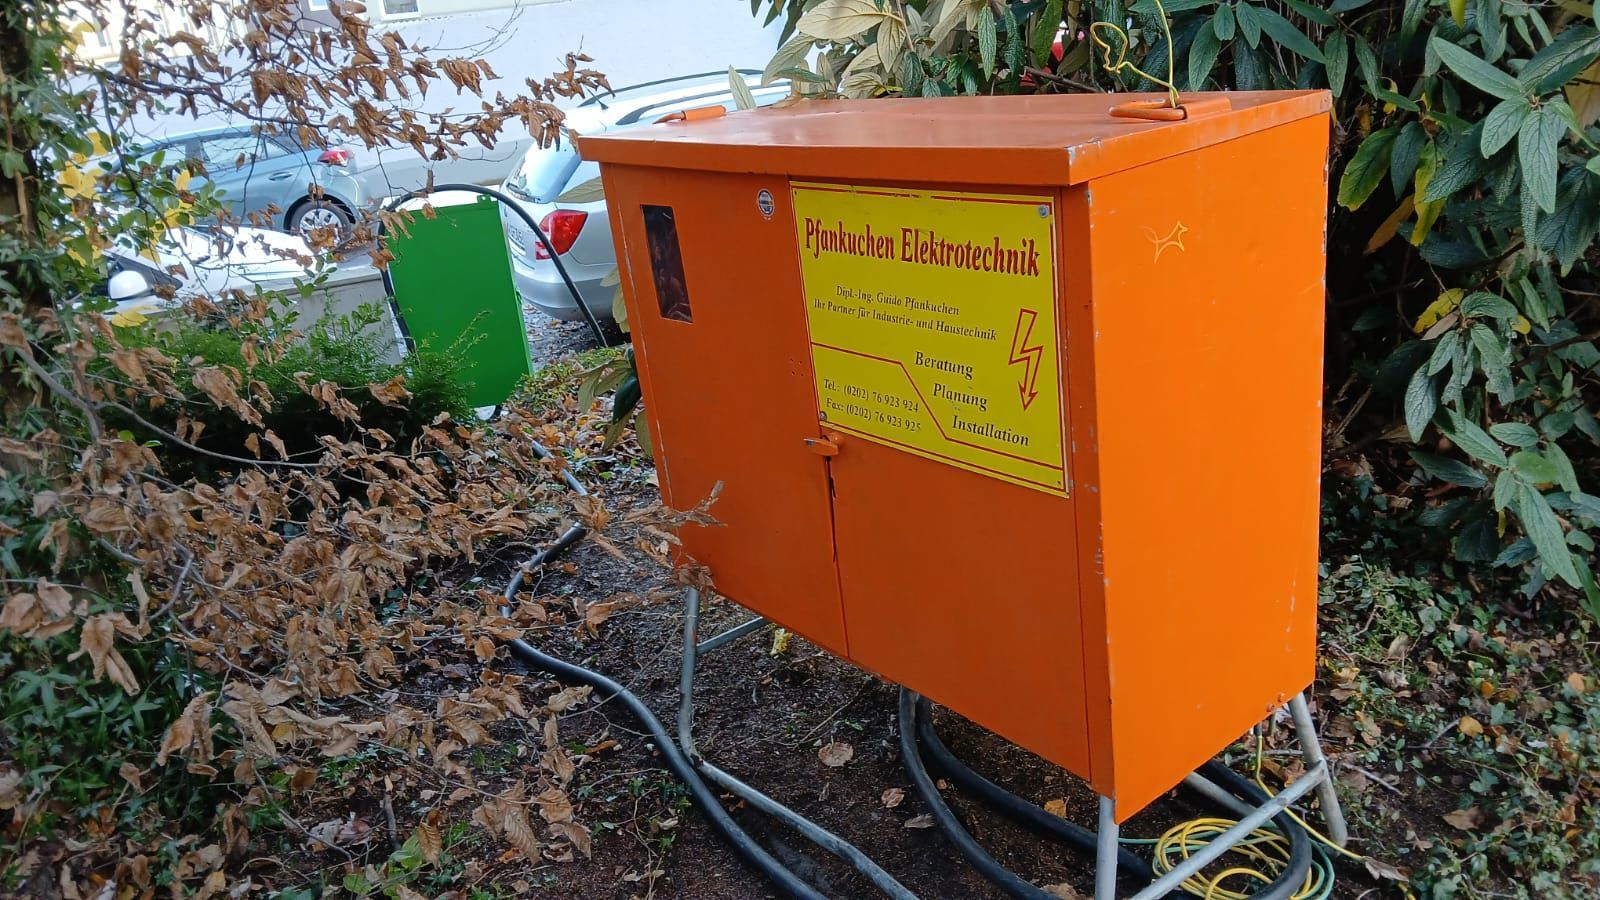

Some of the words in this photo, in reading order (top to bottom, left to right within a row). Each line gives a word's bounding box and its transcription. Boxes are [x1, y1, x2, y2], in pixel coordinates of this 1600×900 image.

[805, 217, 895, 260] Pfankuchen
[900, 227, 1040, 277] Elektrotechnik
[836, 285, 874, 303] Dipl.-Ing.
[876, 291, 902, 307] Guido
[904, 296, 960, 316] Pfankuchen
[814, 299, 825, 310] Ihr
[827, 301, 856, 316] Partner
[857, 306, 871, 319] für
[872, 308, 914, 326] Industrie-
[916, 315, 934, 331] und
[936, 320, 997, 341] Haustechnik
[915, 351, 973, 380] Beratung
[823, 378, 840, 392] Tel.:
[844, 384, 869, 401] (0202)
[872, 391, 882, 404] 76
[883, 394, 900, 408] 923
[902, 399, 919, 413] 924
[933, 383, 988, 412] Planung
[826, 397, 844, 412] Fax:
[846, 402, 872, 421] (0202)
[874, 410, 885, 424] 76
[886, 413, 903, 428] 923
[905, 418, 921, 432] 925
[952, 415, 1029, 447] Installation
